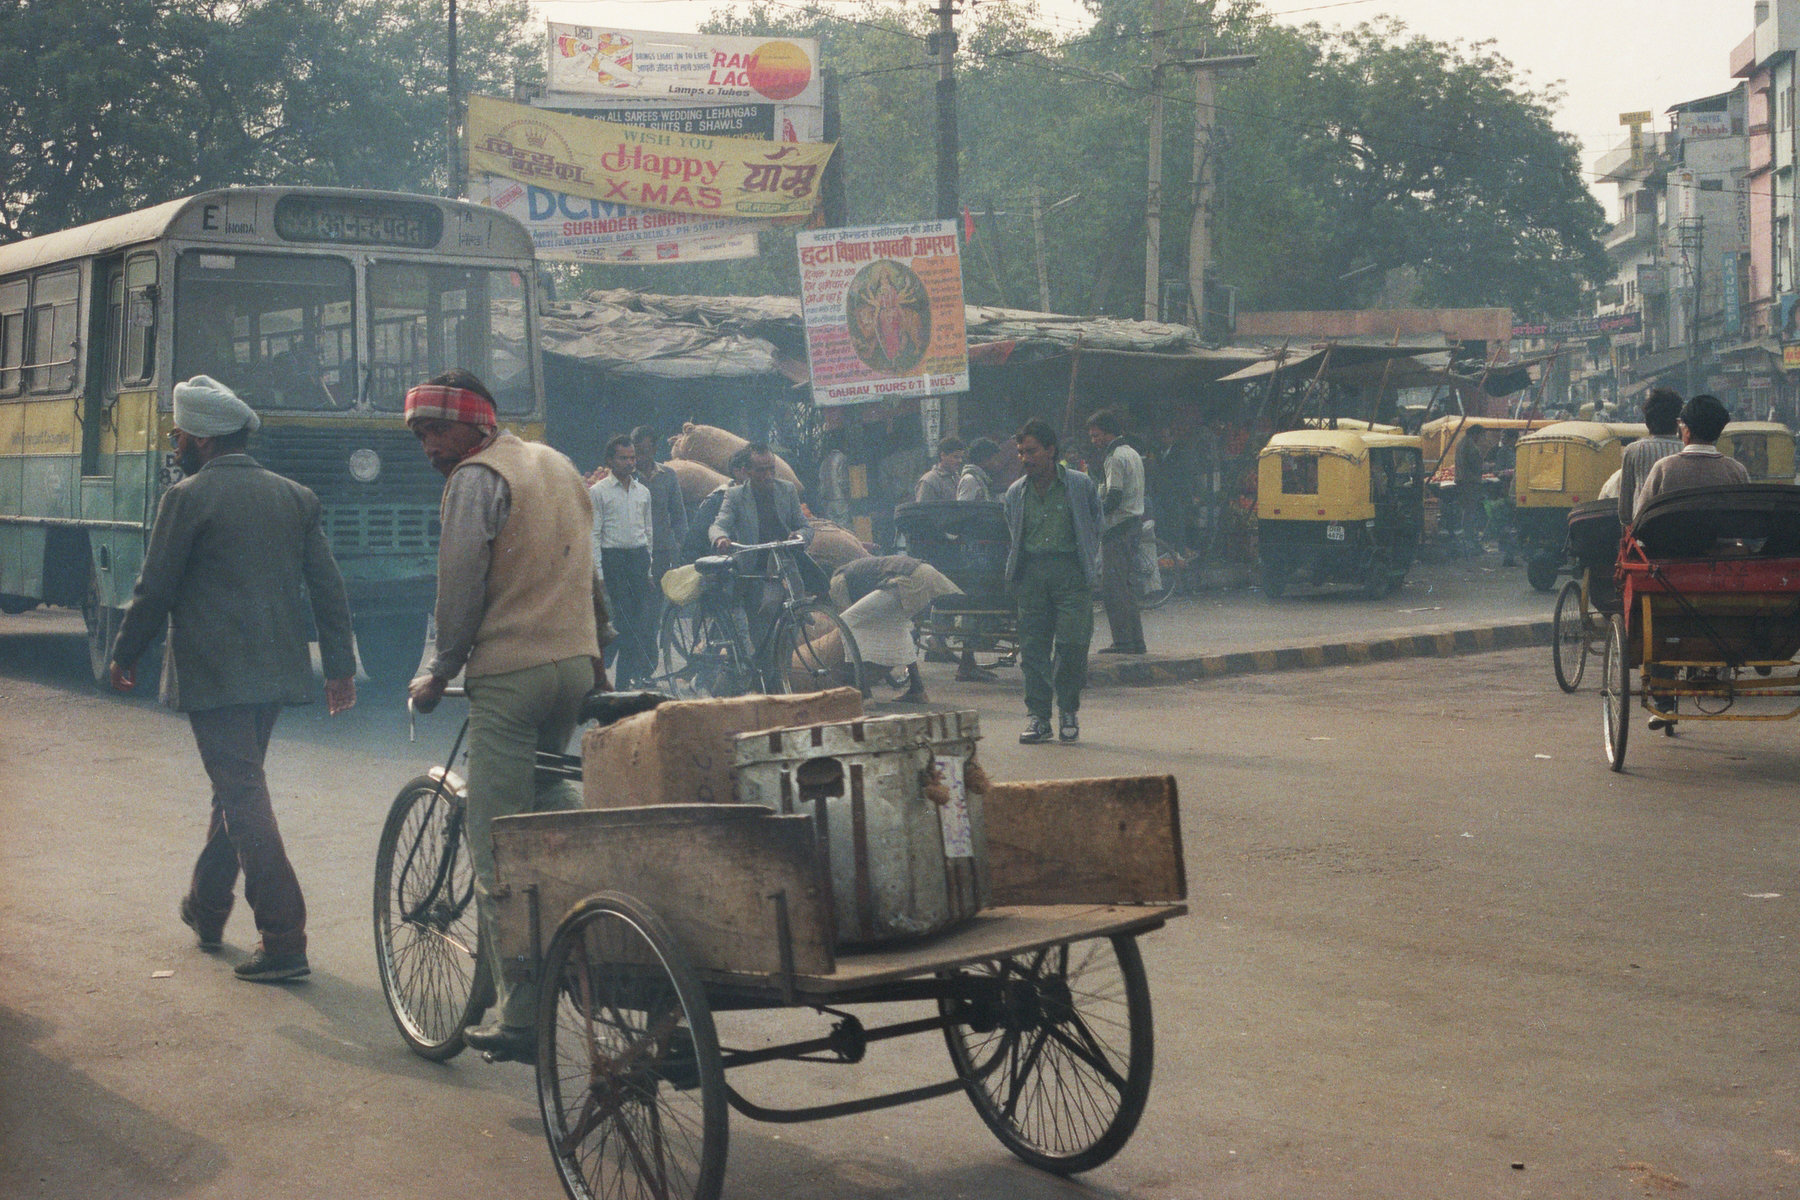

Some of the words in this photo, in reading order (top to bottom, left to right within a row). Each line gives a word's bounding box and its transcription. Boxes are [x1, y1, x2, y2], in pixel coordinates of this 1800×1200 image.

[657, 52, 674, 61] LIGHT
[694, 51, 709, 60] LIFE
[712, 51, 760, 70] RAM
[668, 85, 704, 97] Lamps
[718, 87, 751, 98] Tubes
[607, 111, 622, 122] ALL
[624, 110, 659, 122] SAREES
[660, 109, 703, 121] WEDDING
[705, 106, 758, 119] LEHANGAS
[699, 118, 743, 132] SHAWLS
[623, 129, 671, 146] WISH
[680, 136, 714, 151] YOU
[601, 143, 726, 186] Happy
[526, 183, 627, 221] DCM
[603, 177, 723, 210] X-MAS
[203, 204, 219, 230] E
[228, 222, 254, 234] NOIDA
[562, 216, 638, 237] SURINDER
[643, 210, 689, 229] SINGH
[828, 385, 870, 399] GAURAV
[873, 381, 907, 393] TOURS
[908, 379, 916, 390] &
[917, 376, 956, 389] TAVELS
